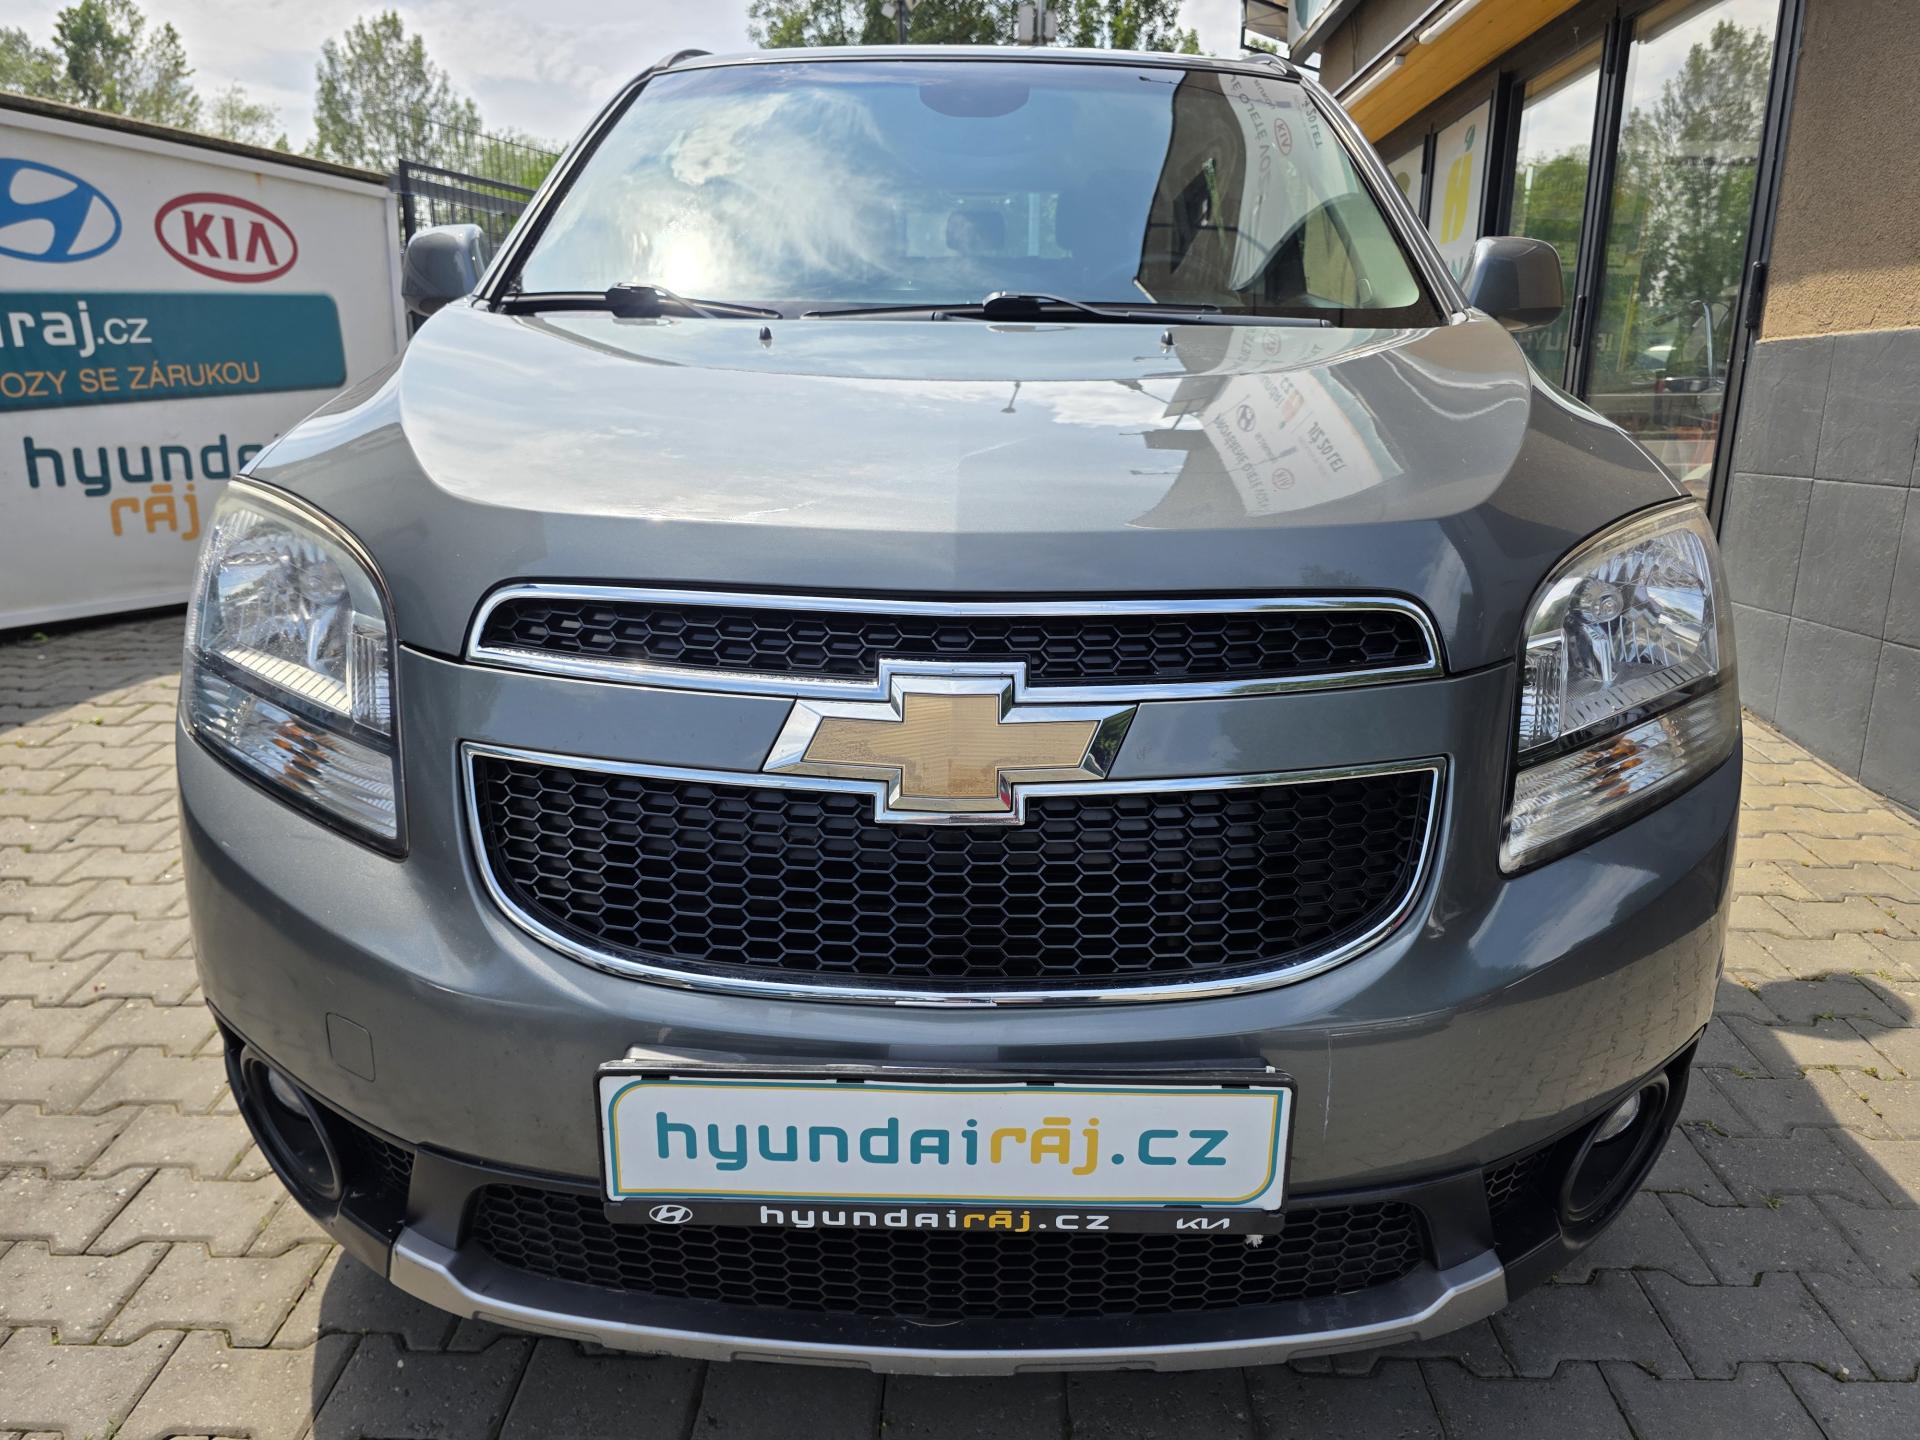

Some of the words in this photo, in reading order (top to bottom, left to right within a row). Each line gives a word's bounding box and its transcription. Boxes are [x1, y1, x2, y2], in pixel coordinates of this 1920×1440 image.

[181, 210, 279, 266] KIA
[79, 368, 120, 393] SE
[128, 360, 260, 390] ZÁRUKOU
